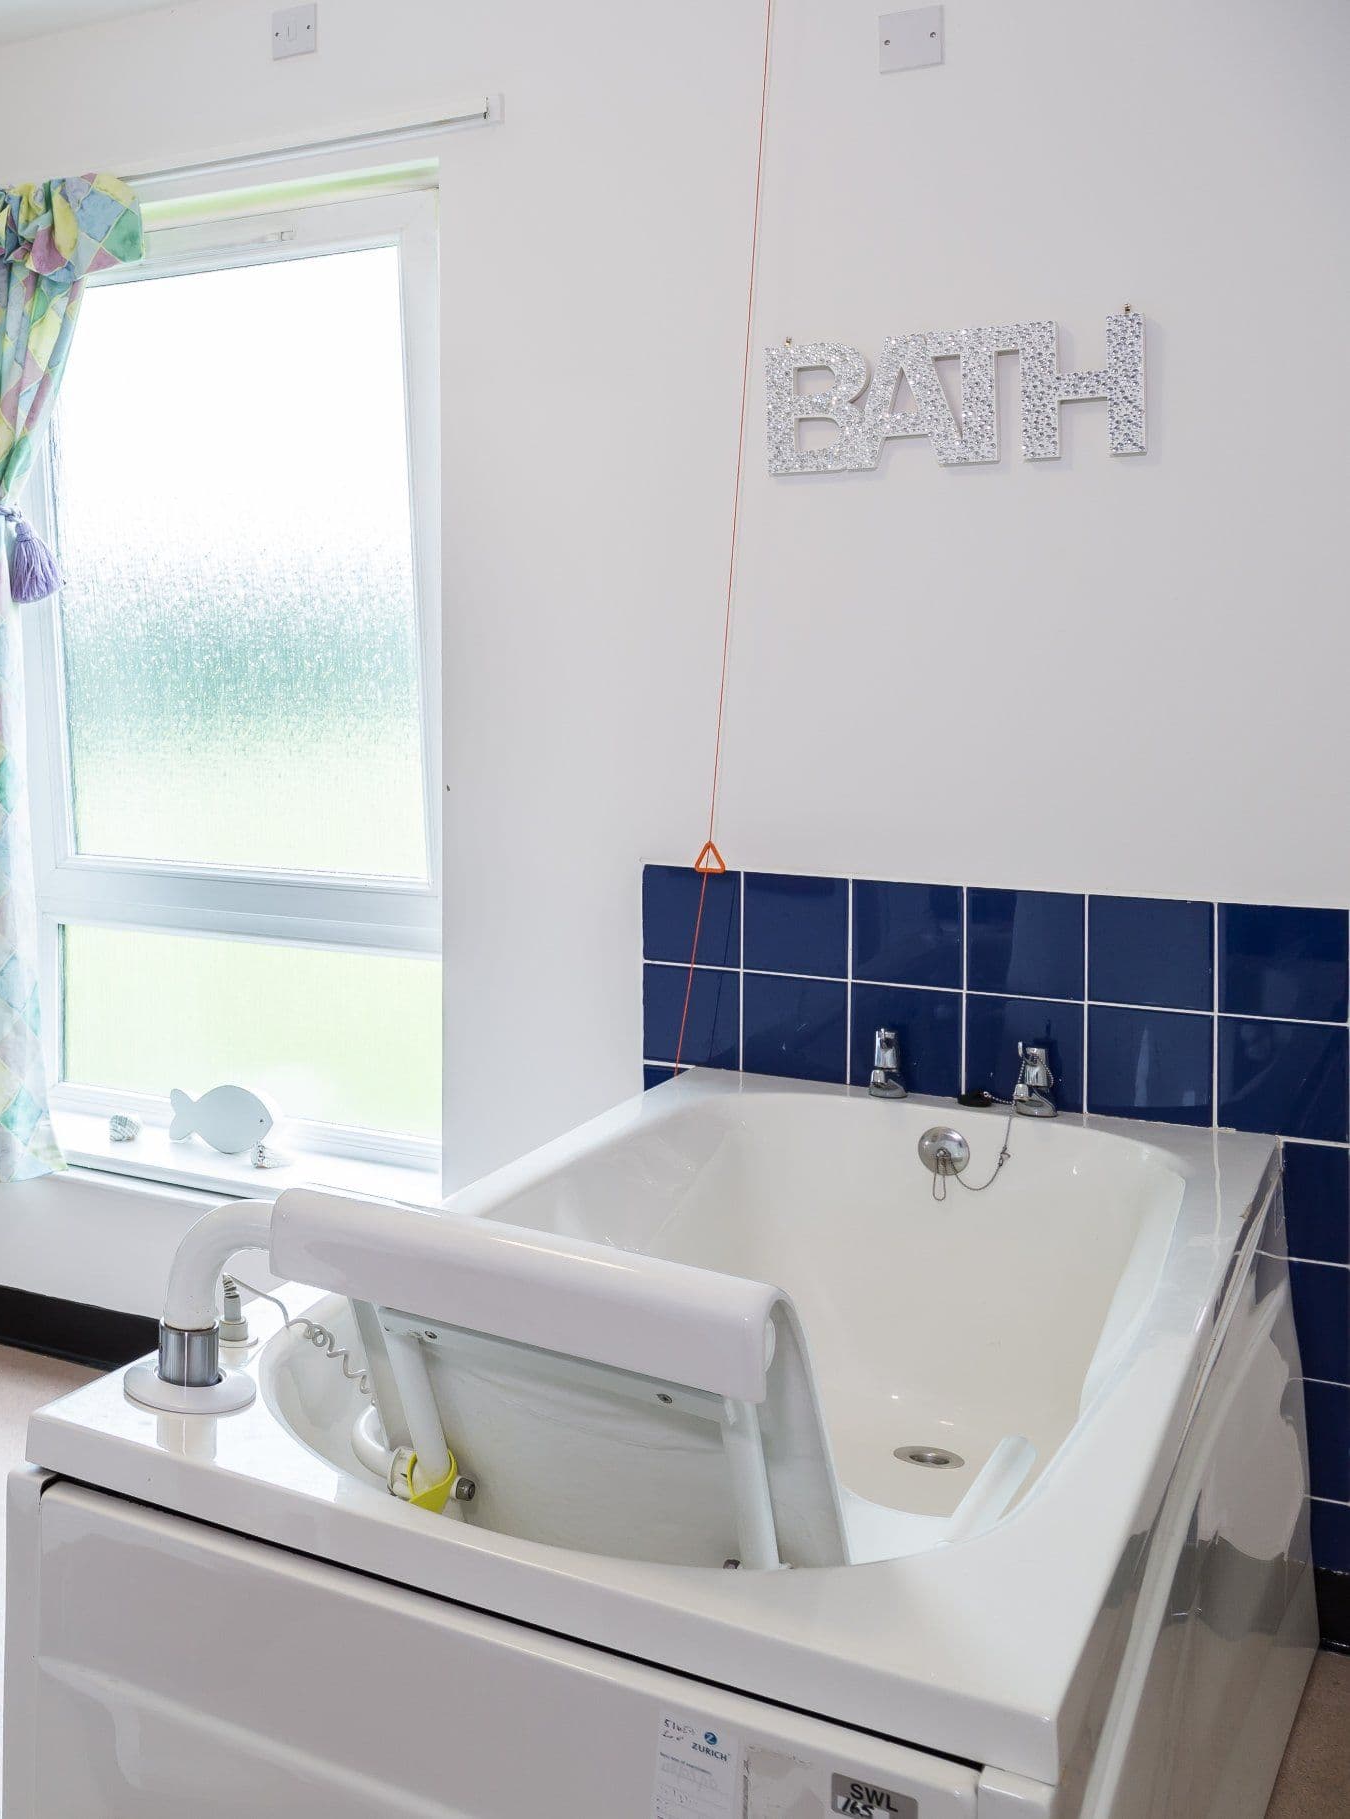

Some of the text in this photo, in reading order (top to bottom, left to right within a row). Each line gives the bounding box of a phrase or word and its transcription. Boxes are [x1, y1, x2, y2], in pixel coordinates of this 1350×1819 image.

[763, 312, 1148, 477] BATH
[691, 1742, 728, 1762] ZURICH
[850, 1783, 899, 1813] SWL
